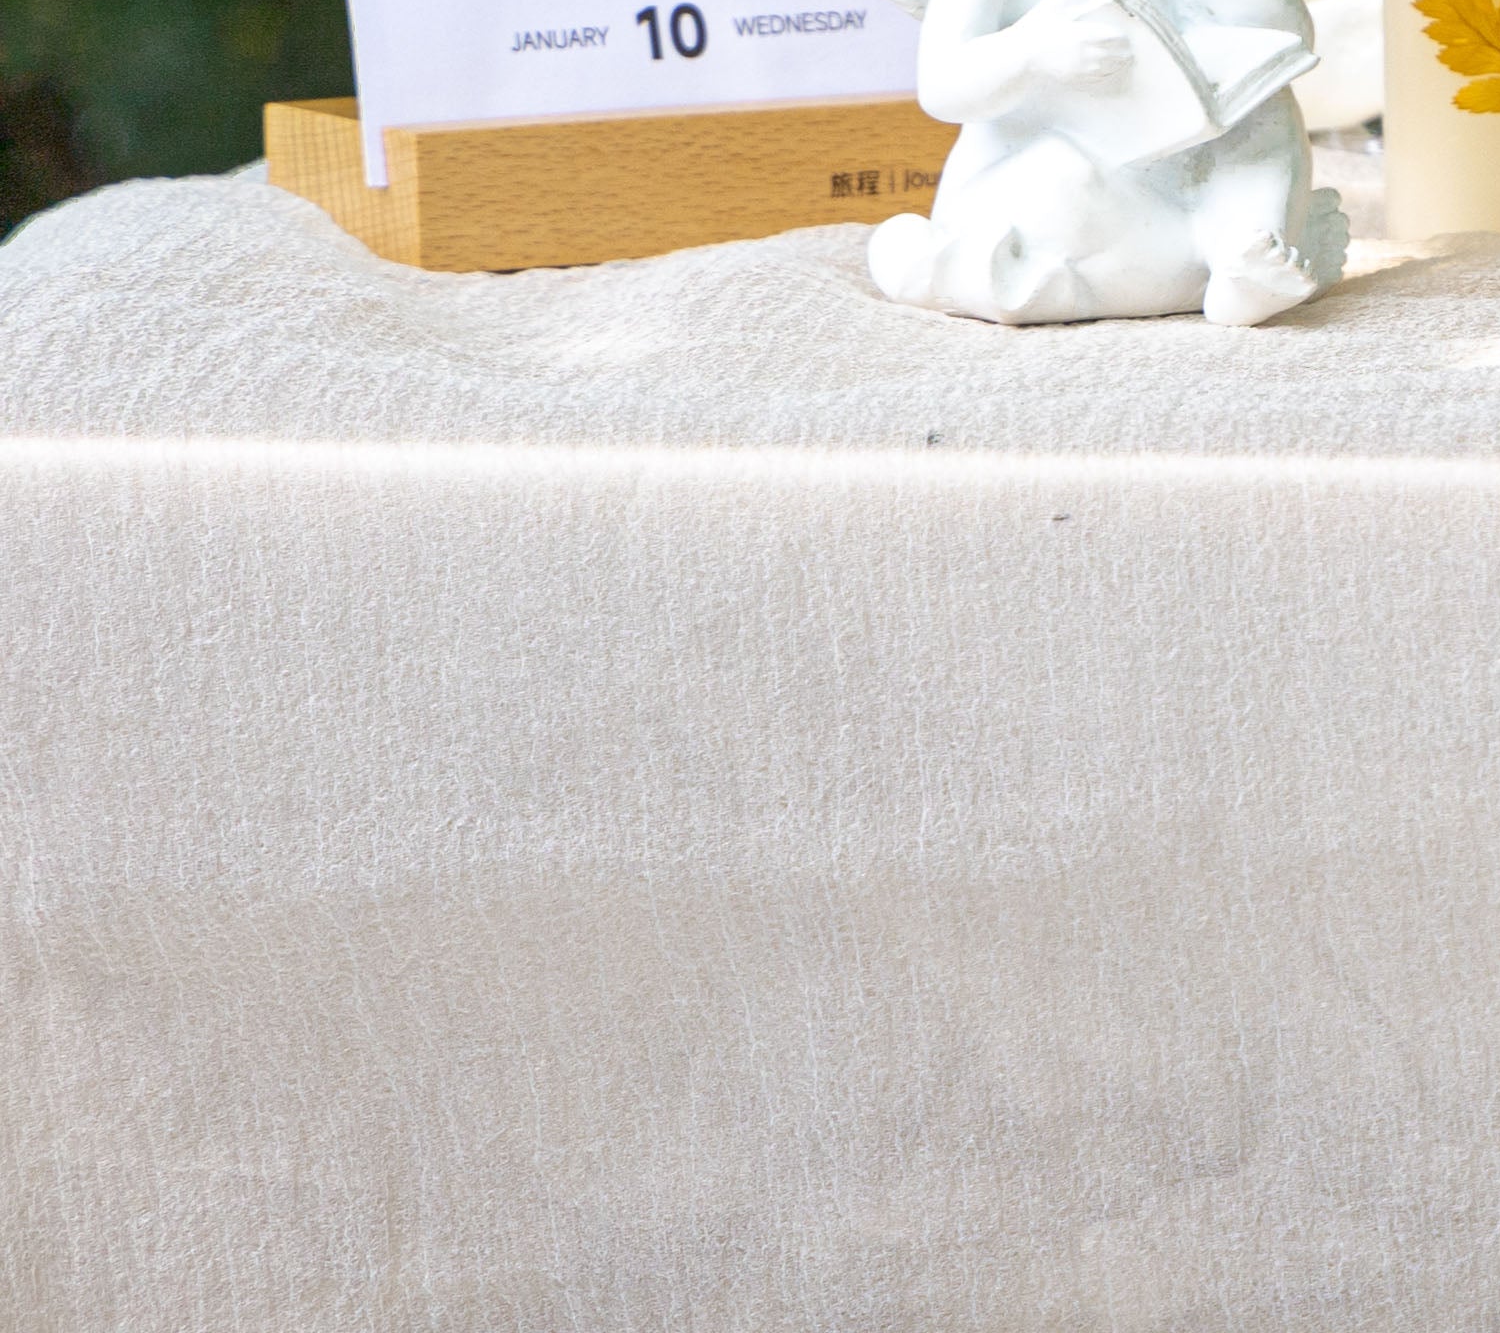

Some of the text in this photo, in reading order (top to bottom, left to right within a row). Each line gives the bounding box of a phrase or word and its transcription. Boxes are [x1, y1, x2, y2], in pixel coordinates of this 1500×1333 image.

[511, 2, 867, 60] JANUARY 10 WEDNESDAY
